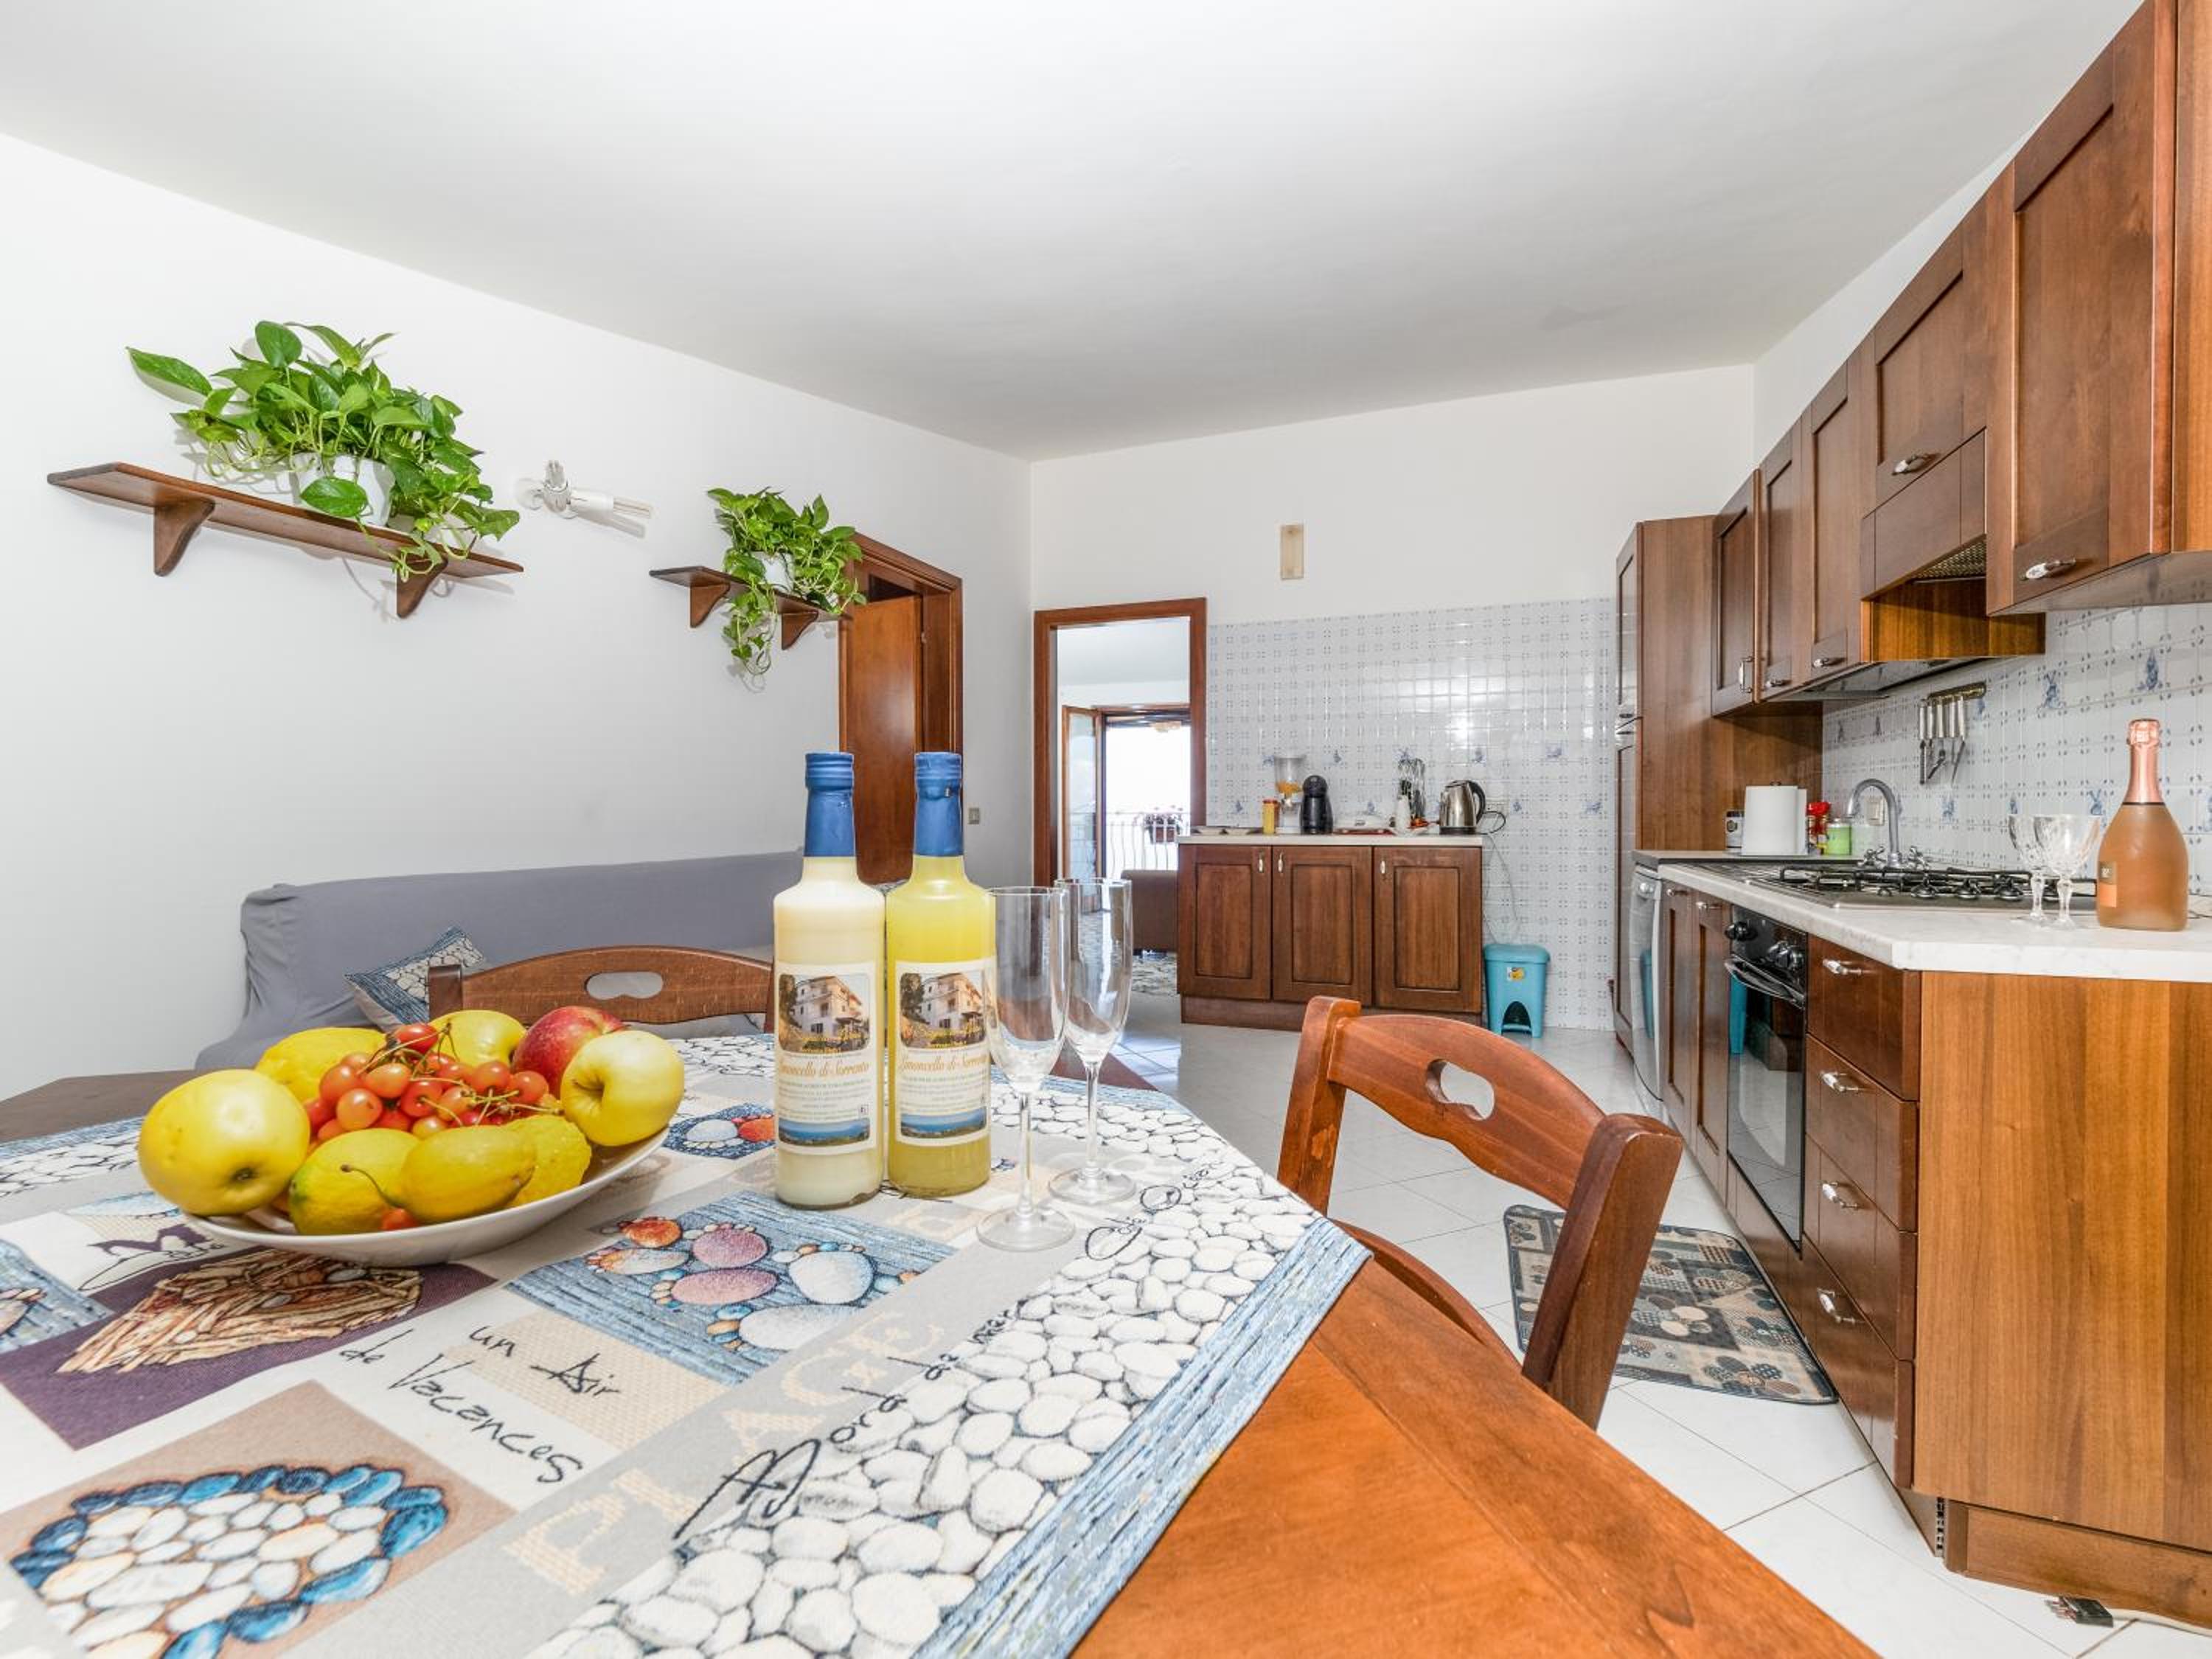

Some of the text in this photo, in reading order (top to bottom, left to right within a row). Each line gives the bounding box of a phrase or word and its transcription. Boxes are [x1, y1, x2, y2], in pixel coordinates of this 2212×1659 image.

[468, 1324, 619, 1396] un Air
[888, 1353, 959, 1381] de
[339, 1329, 582, 1484] de Vacances
